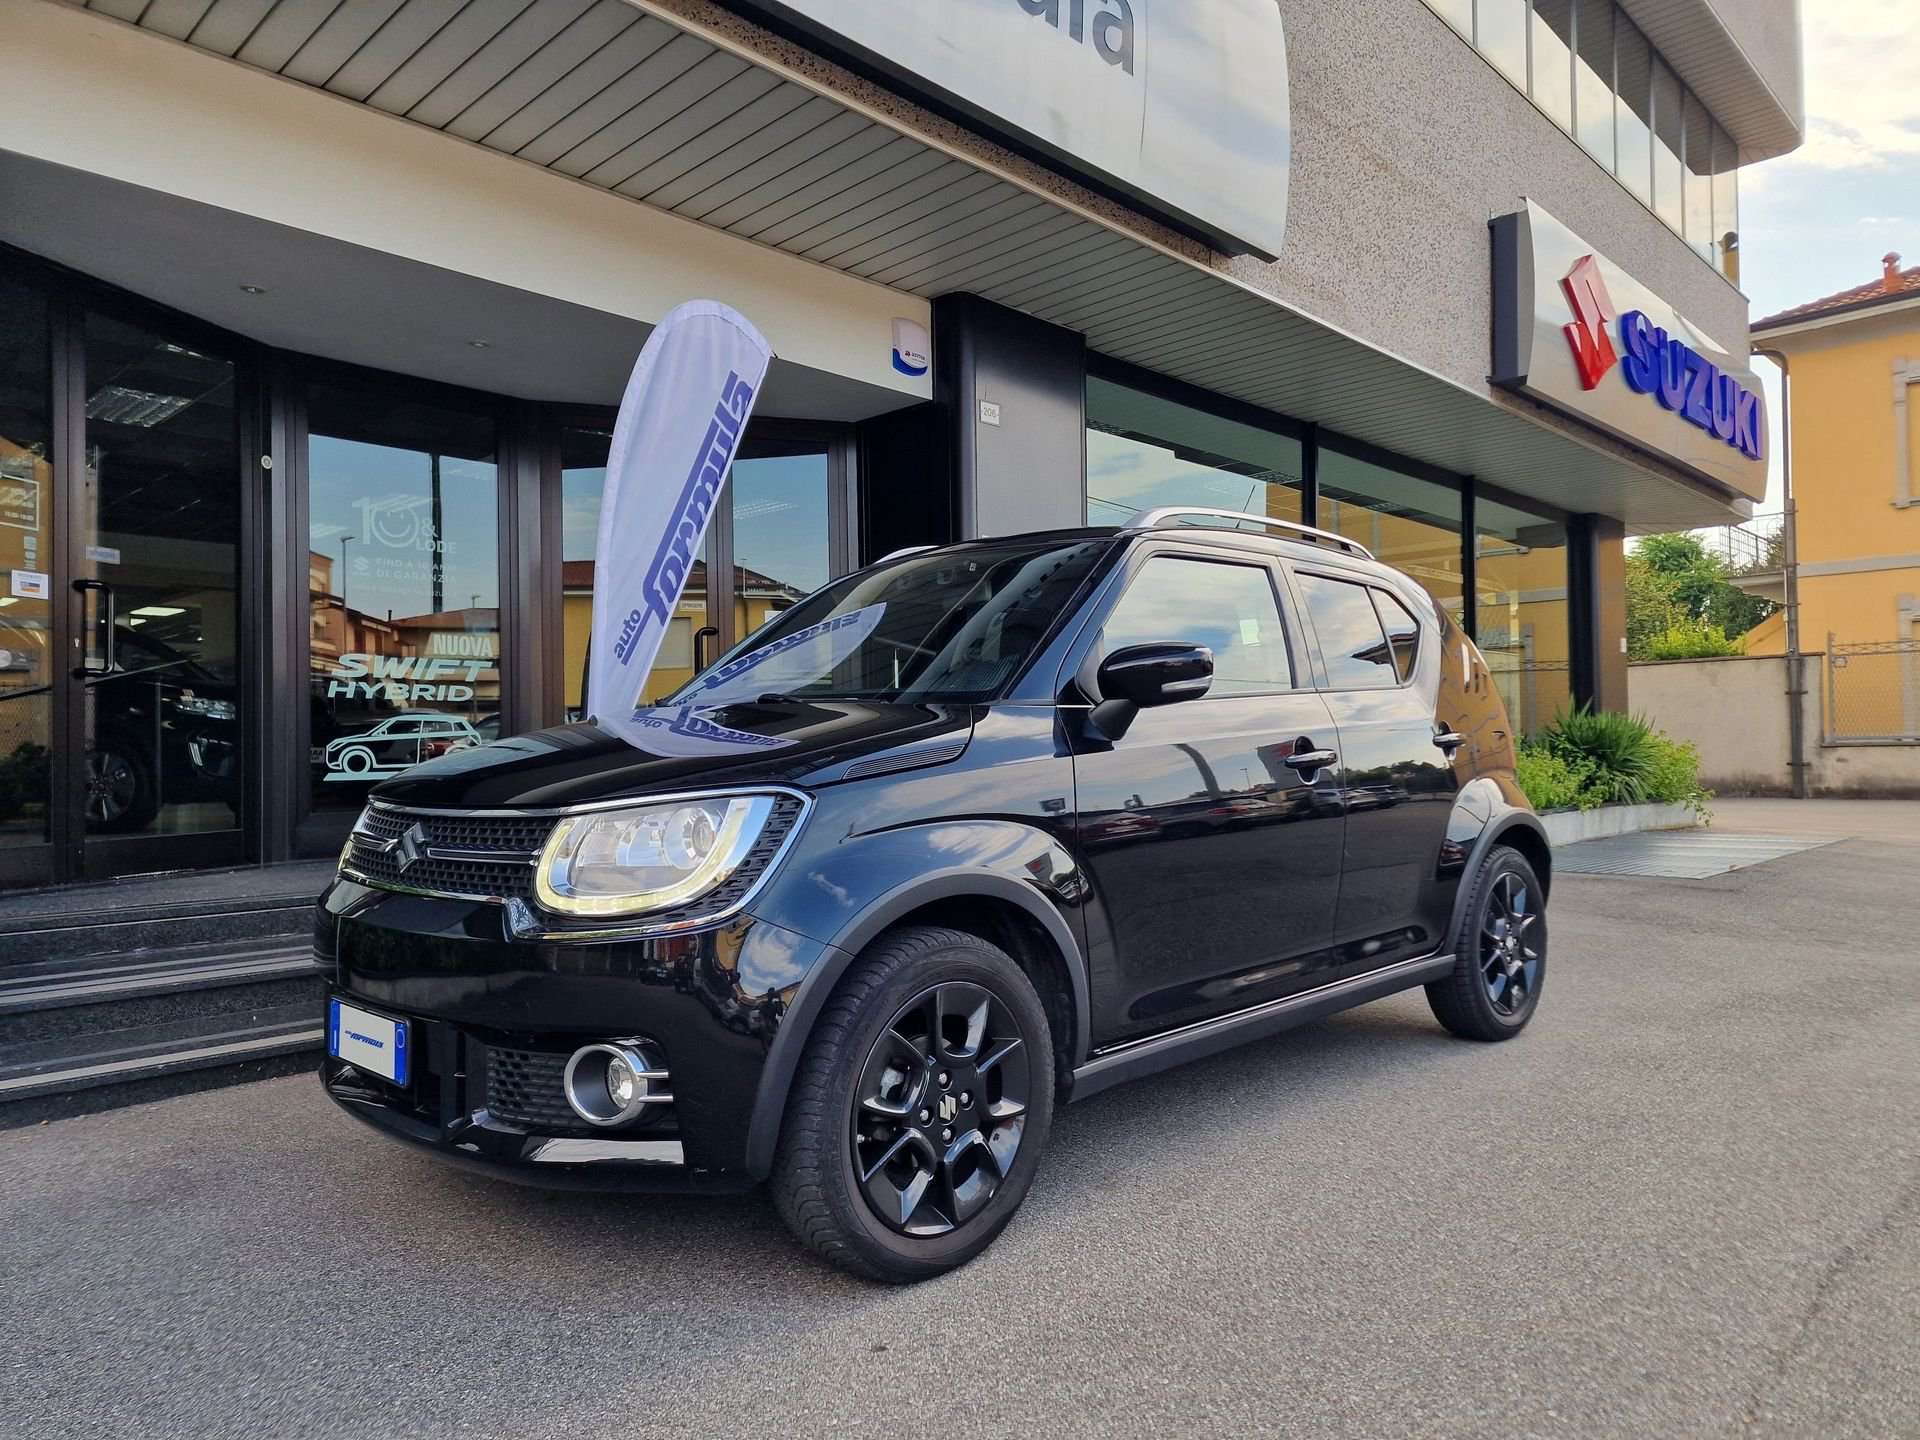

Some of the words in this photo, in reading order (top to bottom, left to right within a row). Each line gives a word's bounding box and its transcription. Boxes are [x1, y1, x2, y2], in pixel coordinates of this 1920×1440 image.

[1621, 310, 1763, 460] SUZUKI
[642, 370, 753, 627] formula
[416, 538, 457, 553] LODE
[433, 632, 494, 657] NUOVA
[614, 608, 642, 660] auto
[331, 652, 493, 683] SWIFT
[327, 680, 474, 702] HYBRID
